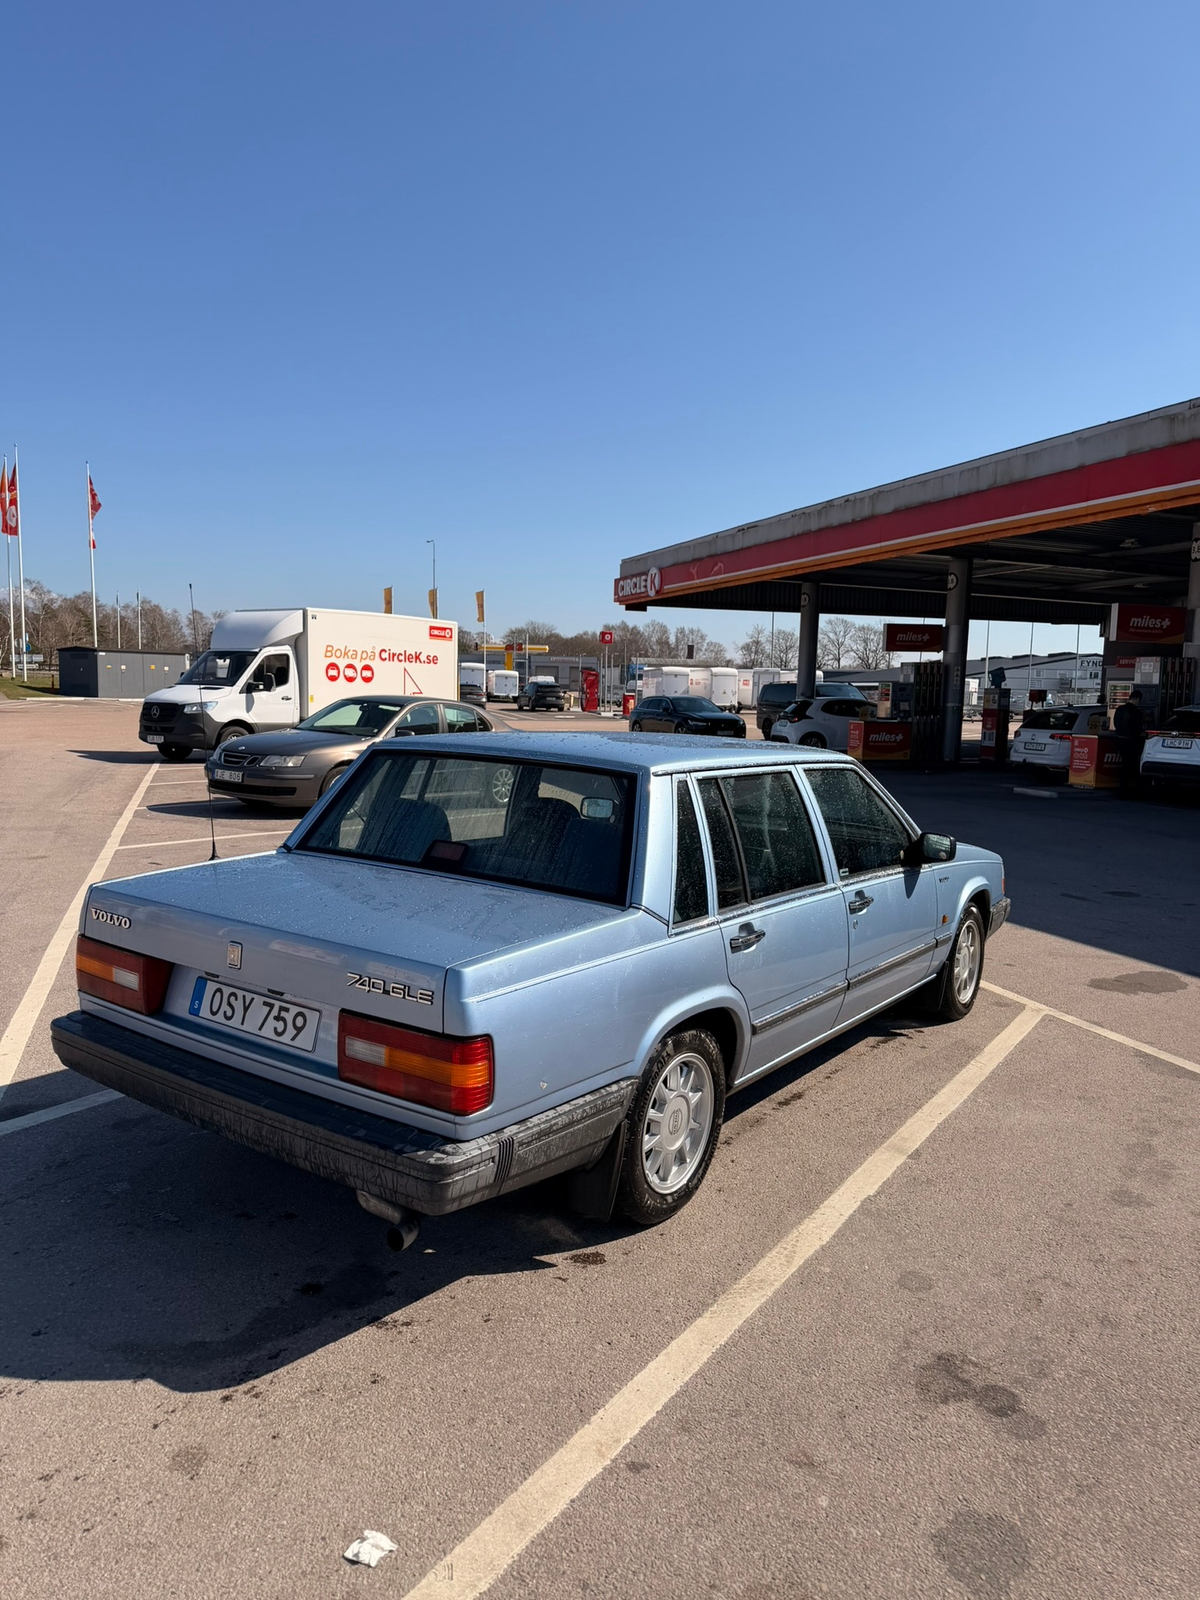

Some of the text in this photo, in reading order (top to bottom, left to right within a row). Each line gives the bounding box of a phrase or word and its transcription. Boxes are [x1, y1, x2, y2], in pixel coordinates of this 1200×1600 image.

[618, 575, 648, 597] CIRCLE
[324, 644, 438, 665] Boka på CircleK.se
[229, 771, 241, 781] 806
[91, 907, 131, 929] VOLVO
[347, 972, 434, 1005] 740 GLE
[194, 1000, 199, 1009] S
[209, 987, 307, 1042] OSY 759
